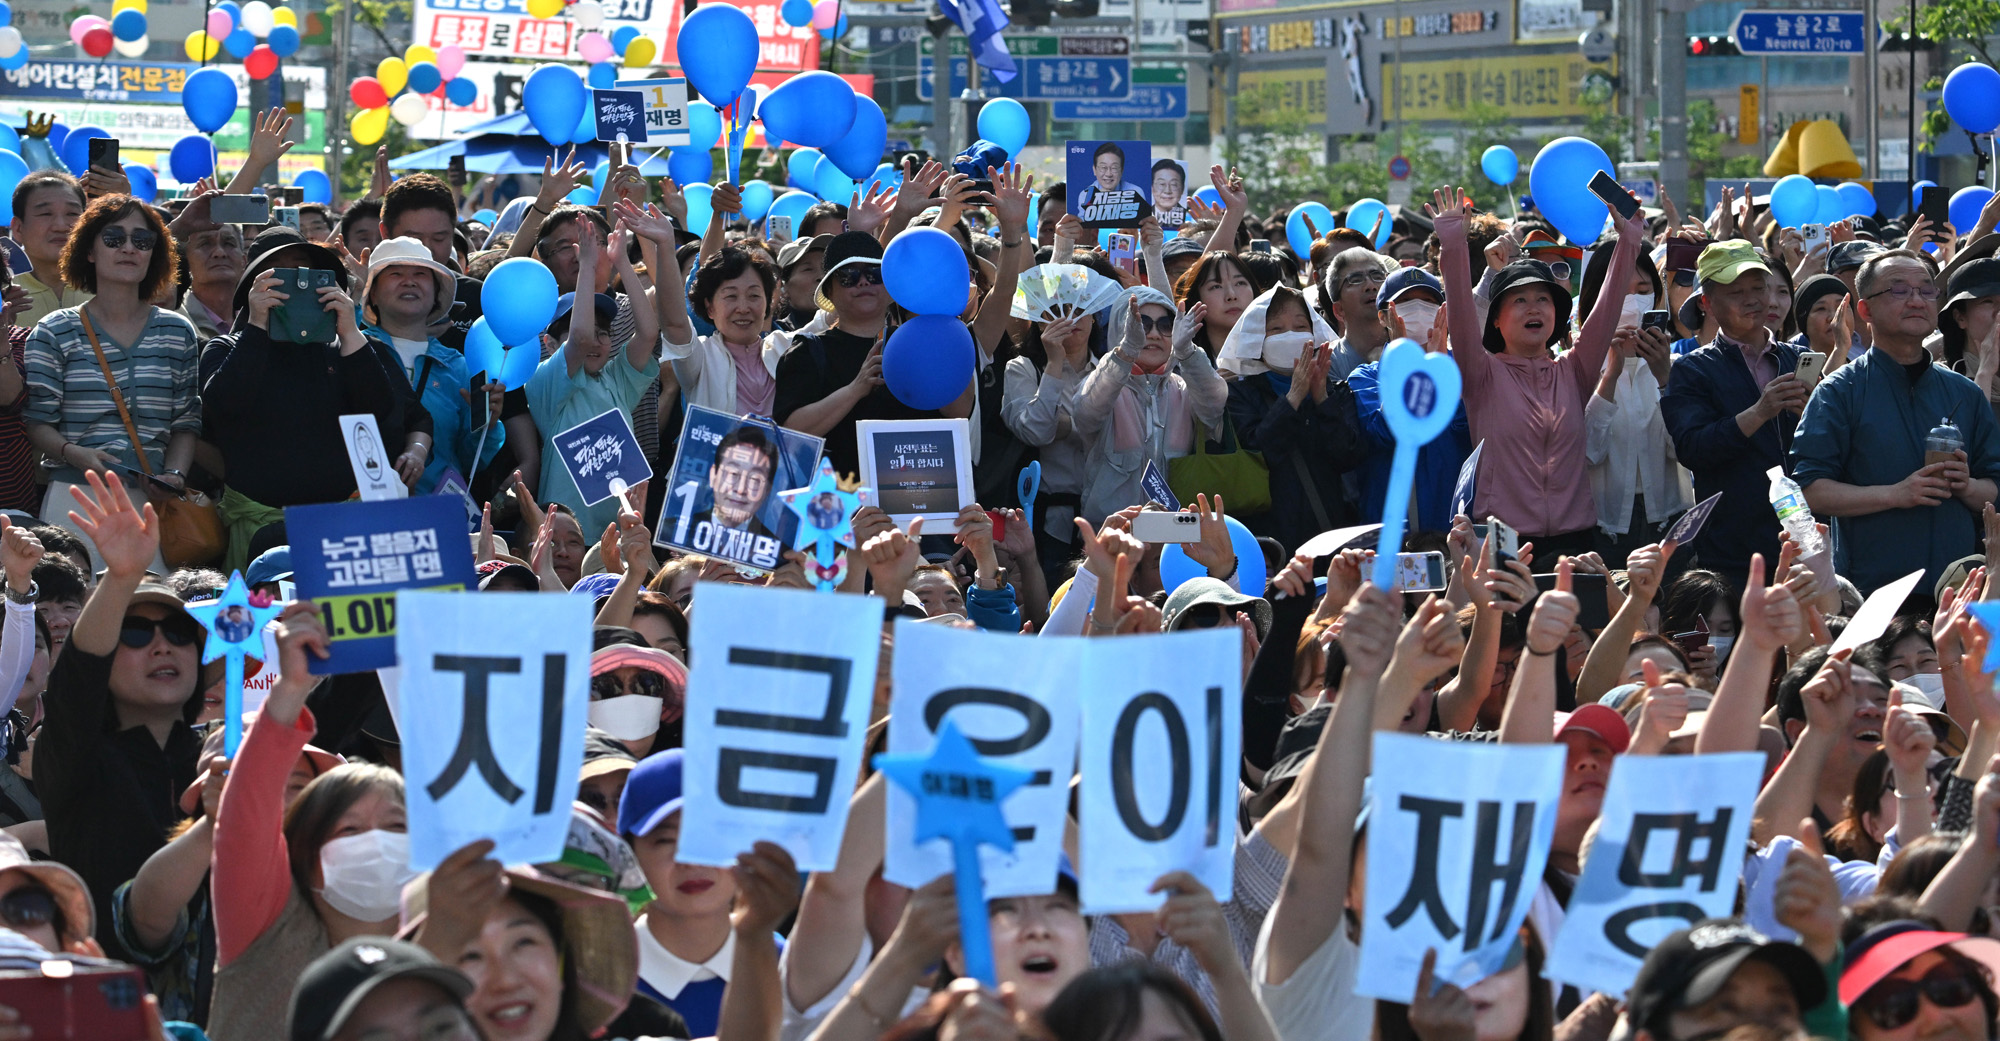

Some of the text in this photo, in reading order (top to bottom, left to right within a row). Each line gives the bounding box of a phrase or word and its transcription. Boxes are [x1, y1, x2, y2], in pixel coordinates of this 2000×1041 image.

[1743, 25, 1758, 40] 12
[1765, 38, 1811, 49] Neureul
[652, 86, 668, 108] 1
[1093, 190, 1136, 205] 지금은
[1084, 202, 1140, 222] 이재명
[690, 427, 723, 447] 민주당
[579, 440, 625, 478] 대한민국
[893, 444, 938, 454] 사전투표는
[917, 458, 944, 468] 합시다
[673, 480, 781, 568] 1 이재명
[321, 528, 438, 560] 누구 뽑을지
[325, 552, 443, 588] 고민될 땐
[347, 597, 397, 636] 이
